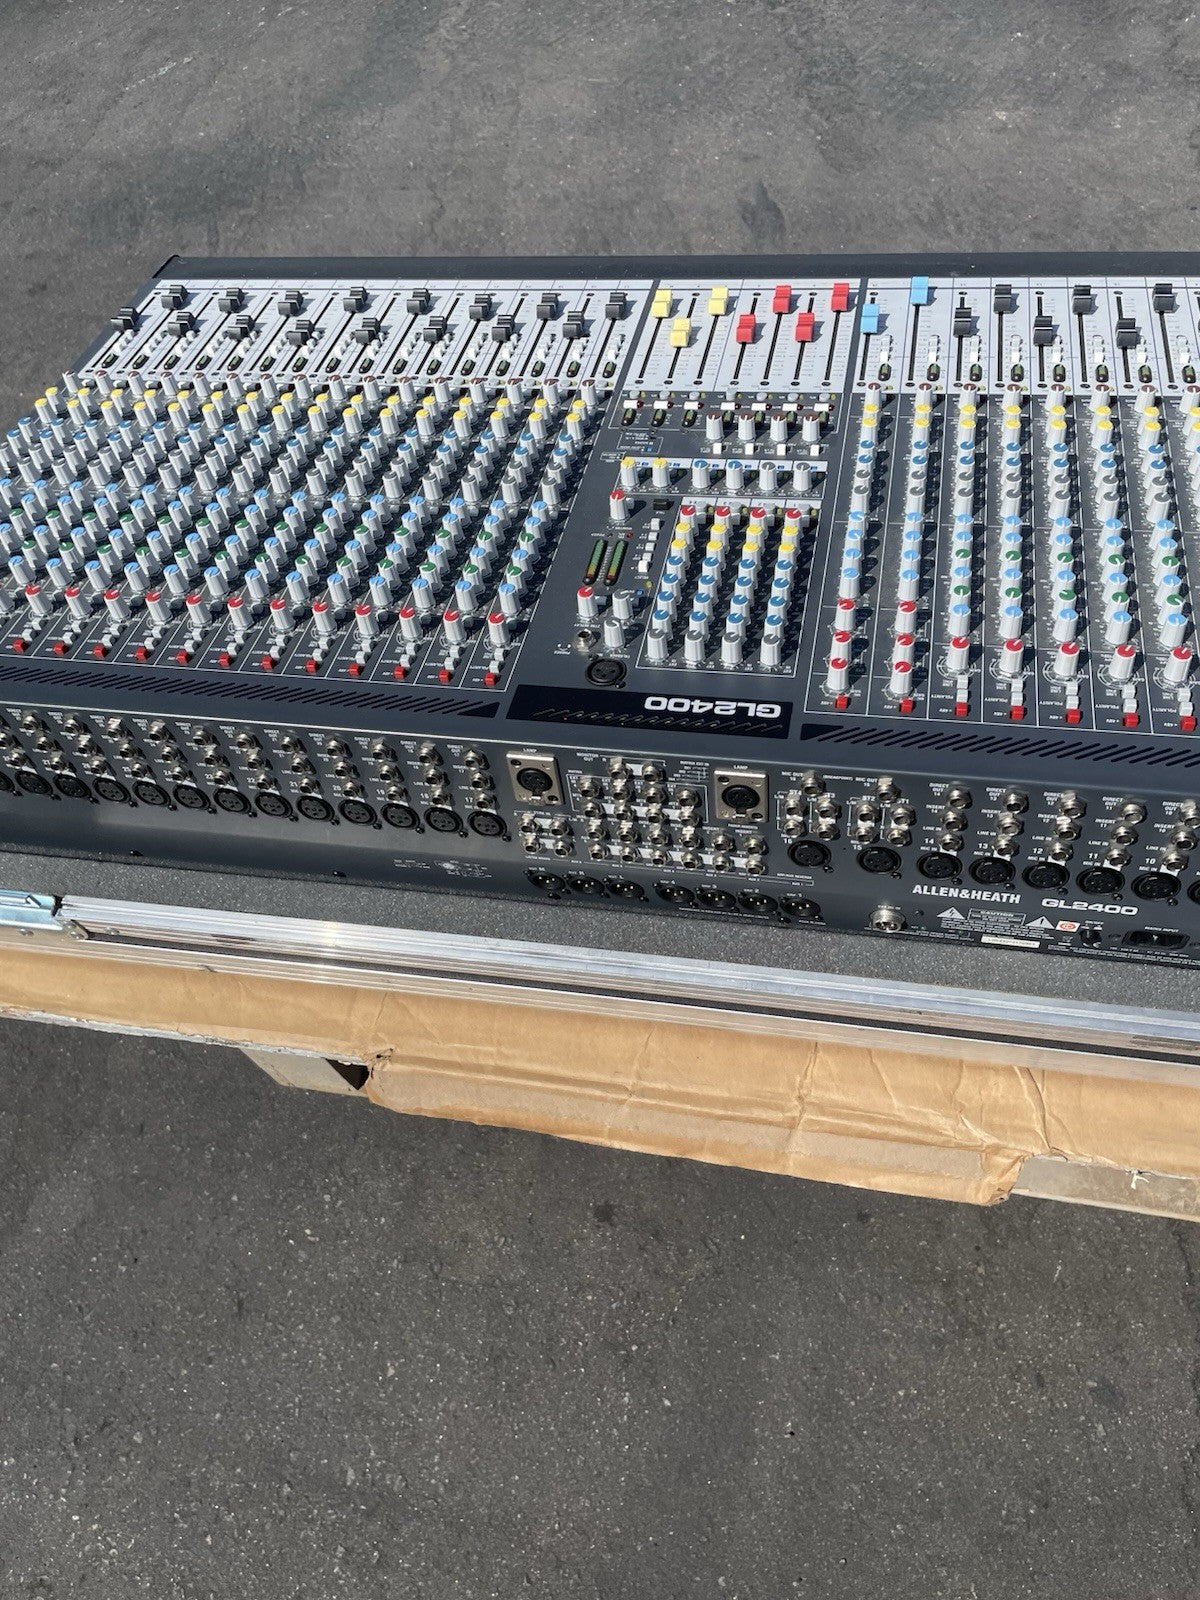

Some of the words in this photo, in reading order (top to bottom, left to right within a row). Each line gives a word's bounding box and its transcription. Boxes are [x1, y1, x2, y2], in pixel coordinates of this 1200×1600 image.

[644, 696, 782, 719] GL2400
[912, 884, 1021, 904] ALLEN&HEATH
[1041, 898, 1138, 916] GL2400
